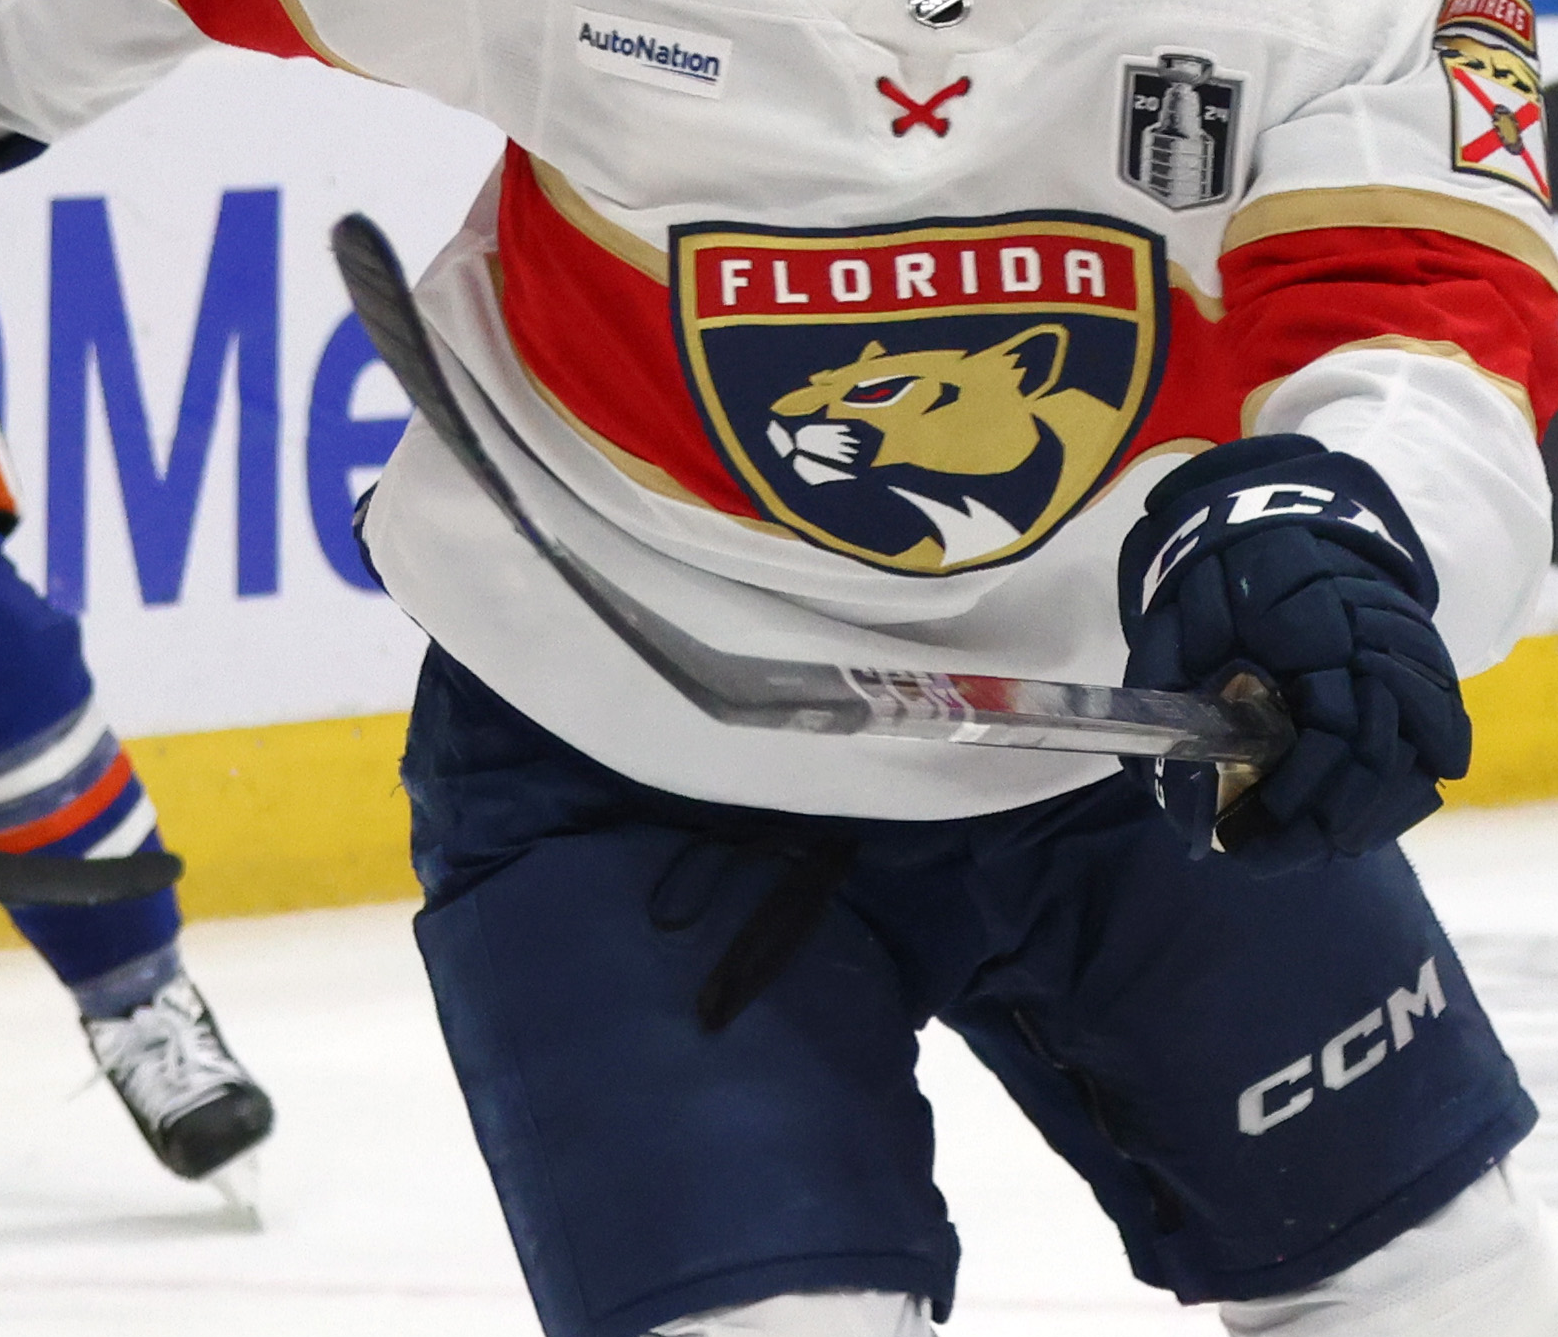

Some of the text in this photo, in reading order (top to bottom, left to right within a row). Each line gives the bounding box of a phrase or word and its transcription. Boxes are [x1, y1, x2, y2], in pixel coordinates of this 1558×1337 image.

[578, 21, 721, 78] AutoNation
[719, 245, 1107, 307] FLORIDA
[1238, 955, 1448, 1136] CCM
